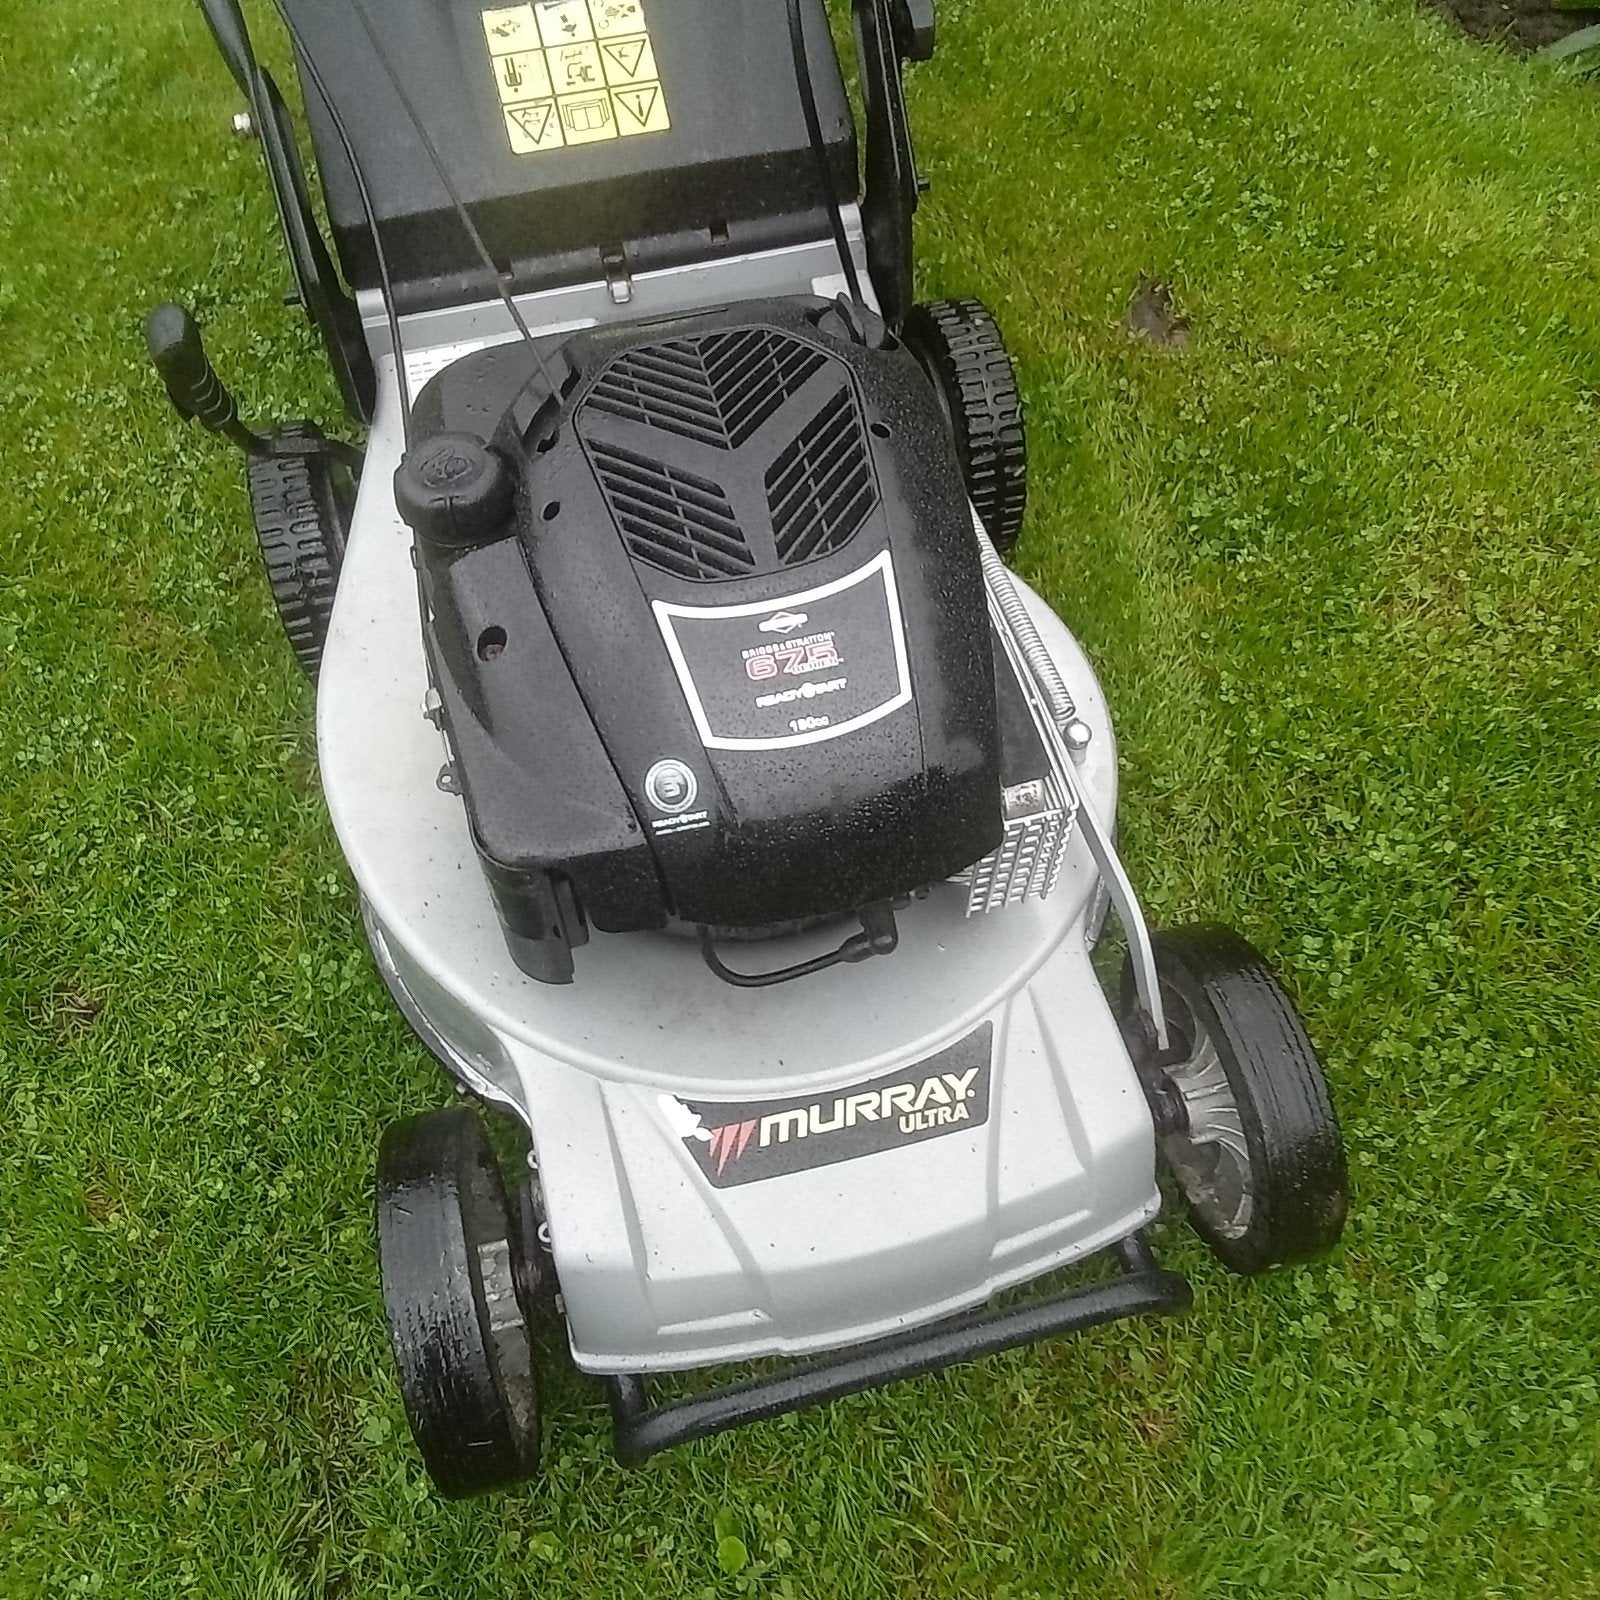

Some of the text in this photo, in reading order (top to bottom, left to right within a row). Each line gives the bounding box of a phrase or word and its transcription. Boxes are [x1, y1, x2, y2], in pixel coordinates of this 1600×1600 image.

[745, 641, 838, 680] 675
[759, 1067, 980, 1147] MURRAY
[898, 1102, 970, 1134] ULTRA
